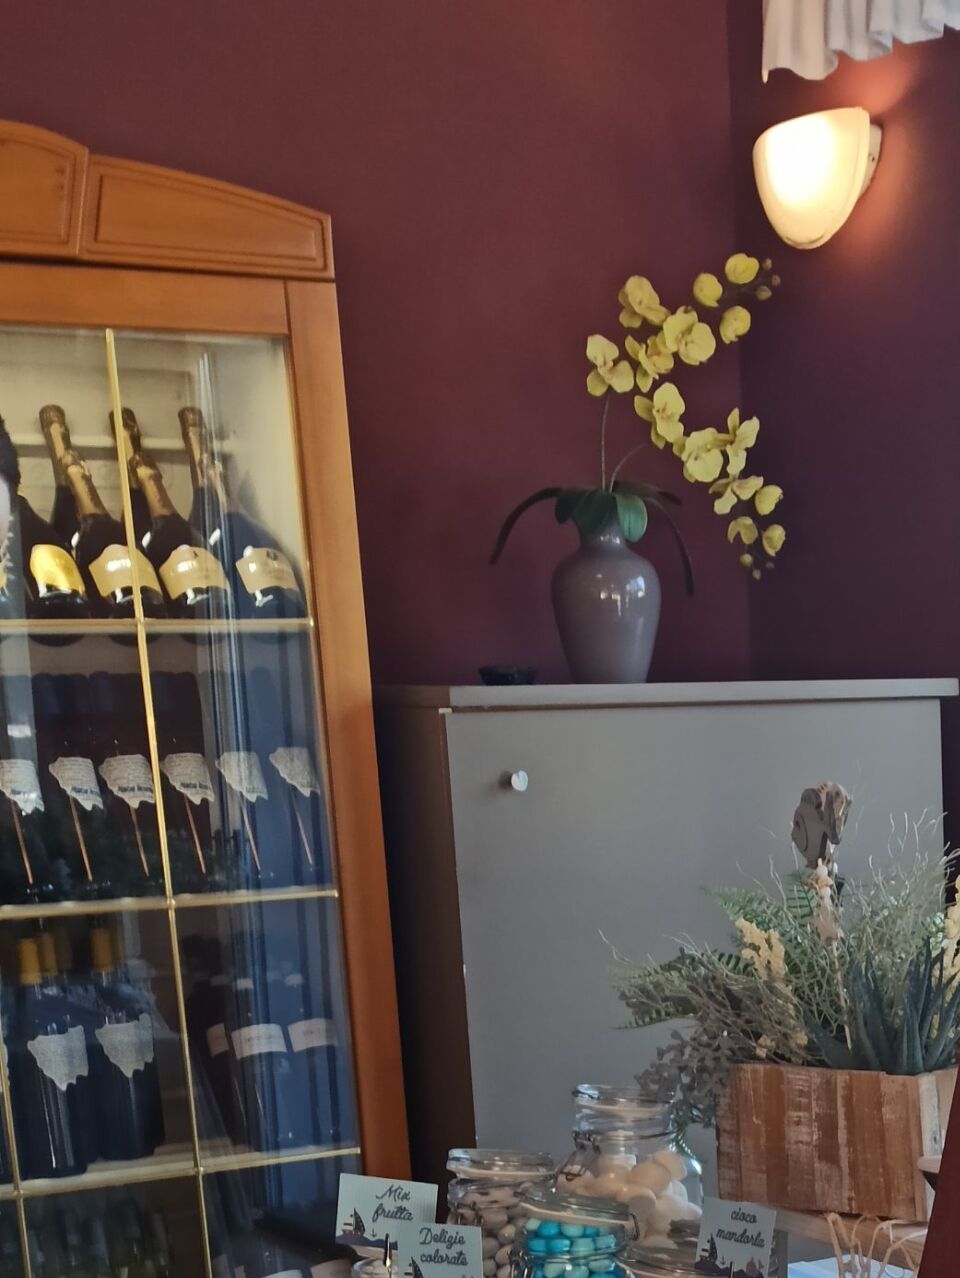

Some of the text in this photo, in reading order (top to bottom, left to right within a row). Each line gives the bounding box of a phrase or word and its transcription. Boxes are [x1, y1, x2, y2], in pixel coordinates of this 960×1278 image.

[376, 1184, 412, 1202] Mix
[372, 1202, 414, 1222] frutta
[419, 1227, 466, 1250] Delizie
[716, 1228, 765, 1248] mandorla
[420, 1249, 469, 1266] colorate
